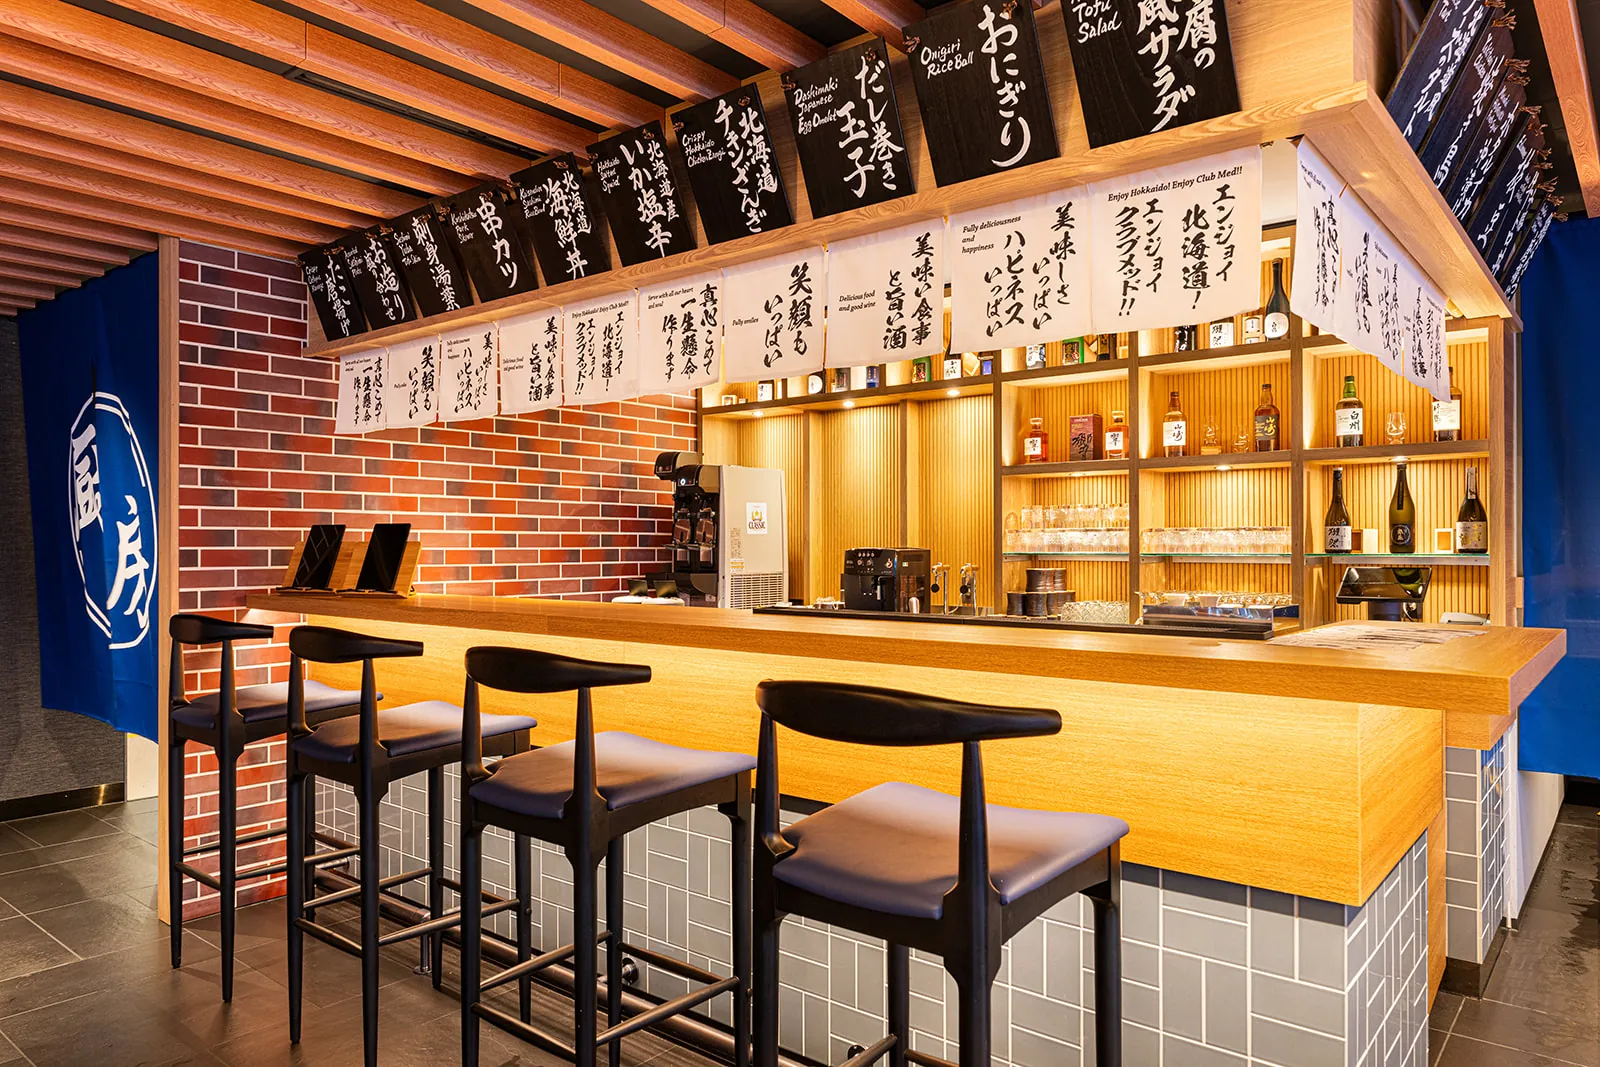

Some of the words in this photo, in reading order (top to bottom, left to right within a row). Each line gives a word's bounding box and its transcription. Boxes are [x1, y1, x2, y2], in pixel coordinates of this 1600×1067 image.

[920, 39, 960, 65] Onigiri
[1078, 11, 1123, 43] Salad
[855, 56, 905, 190] だし巻き
[978, 5, 1031, 168] おにぎり
[646, 140, 680, 222] 北海道産
[738, 107, 778, 193] 北海道
[838, 101, 875, 198] 玉子
[1108, 192, 1130, 201] Enjoy
[1130, 182, 1171, 198] Hokkaido!
[1172, 178, 1195, 190] Enjoy
[1196, 174, 1216, 184] Club
[1217, 166, 1243, 181] Med!!
[543, 178, 588, 281] 海鮮丼
[563, 171, 592, 234] 北海道
[620, 140, 672, 258] いか塩辛
[962, 235, 976, 244] and
[963, 222, 979, 234] Fully
[979, 215, 1022, 231] deliciousness
[1212, 184, 1236, 281] エンジョイ
[369, 239, 406, 320] お造り
[476, 195, 518, 289] 串カツ
[961, 243, 995, 255] happiness
[1003, 230, 1026, 327] ハピネス
[1050, 200, 1077, 305] 美味しさ
[1115, 206, 1142, 316] クラブメッド!!
[1142, 198, 1164, 293] エンジョイ
[1181, 204, 1211, 310] 北海道!
[699, 283, 719, 376] 真心こめて
[787, 261, 813, 356] 笑顔も
[838, 294, 864, 303] Delicious
[863, 289, 876, 300] food
[882, 269, 907, 350] と旨い酒
[910, 231, 935, 346] 美味い食事
[984, 267, 1003, 338] いっぱい
[1032, 256, 1053, 331] いっぱい
[586, 317, 597, 380] エンジョイ
[614, 310, 625, 375] エンジョイ
[661, 313, 679, 384] 作ります
[680, 297, 698, 380] 一生懸命
[763, 294, 784, 369] いっぱい
[408, 366, 419, 420] いっぱい
